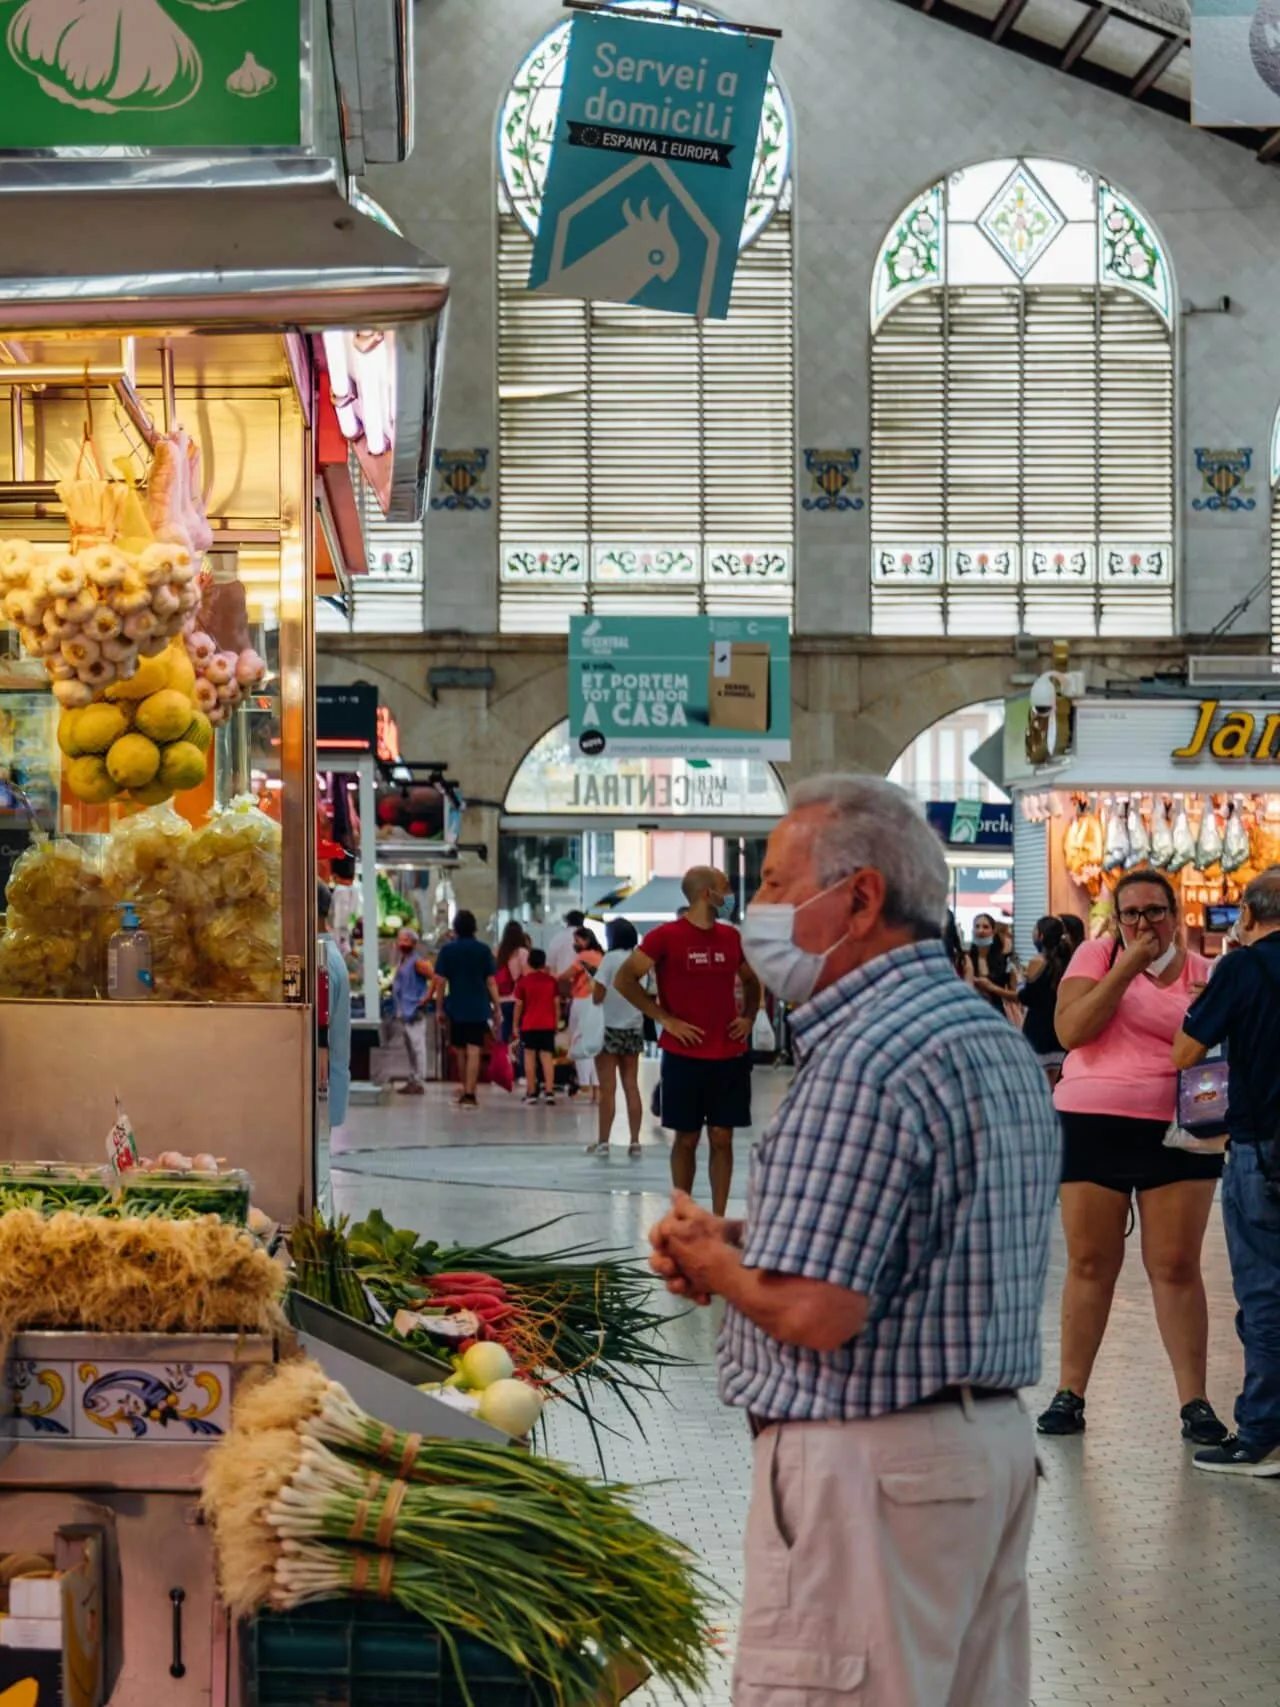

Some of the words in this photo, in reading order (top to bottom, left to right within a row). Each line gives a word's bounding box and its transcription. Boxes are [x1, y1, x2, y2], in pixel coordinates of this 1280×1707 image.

[592, 42, 708, 93] Servei
[716, 71, 738, 98] a
[584, 86, 735, 140] domicili
[602, 133, 658, 154] ESPANYA
[660, 141, 667, 154] I
[670, 143, 720, 162] EUROPA
[581, 673, 604, 688] ET
[611, 673, 689, 689] PORTEM
[582, 689, 610, 702] TOT
[615, 689, 632, 702] EL
[637, 689, 689, 702] SABOR
[582, 702, 600, 727] A
[611, 701, 689, 727] CASA
